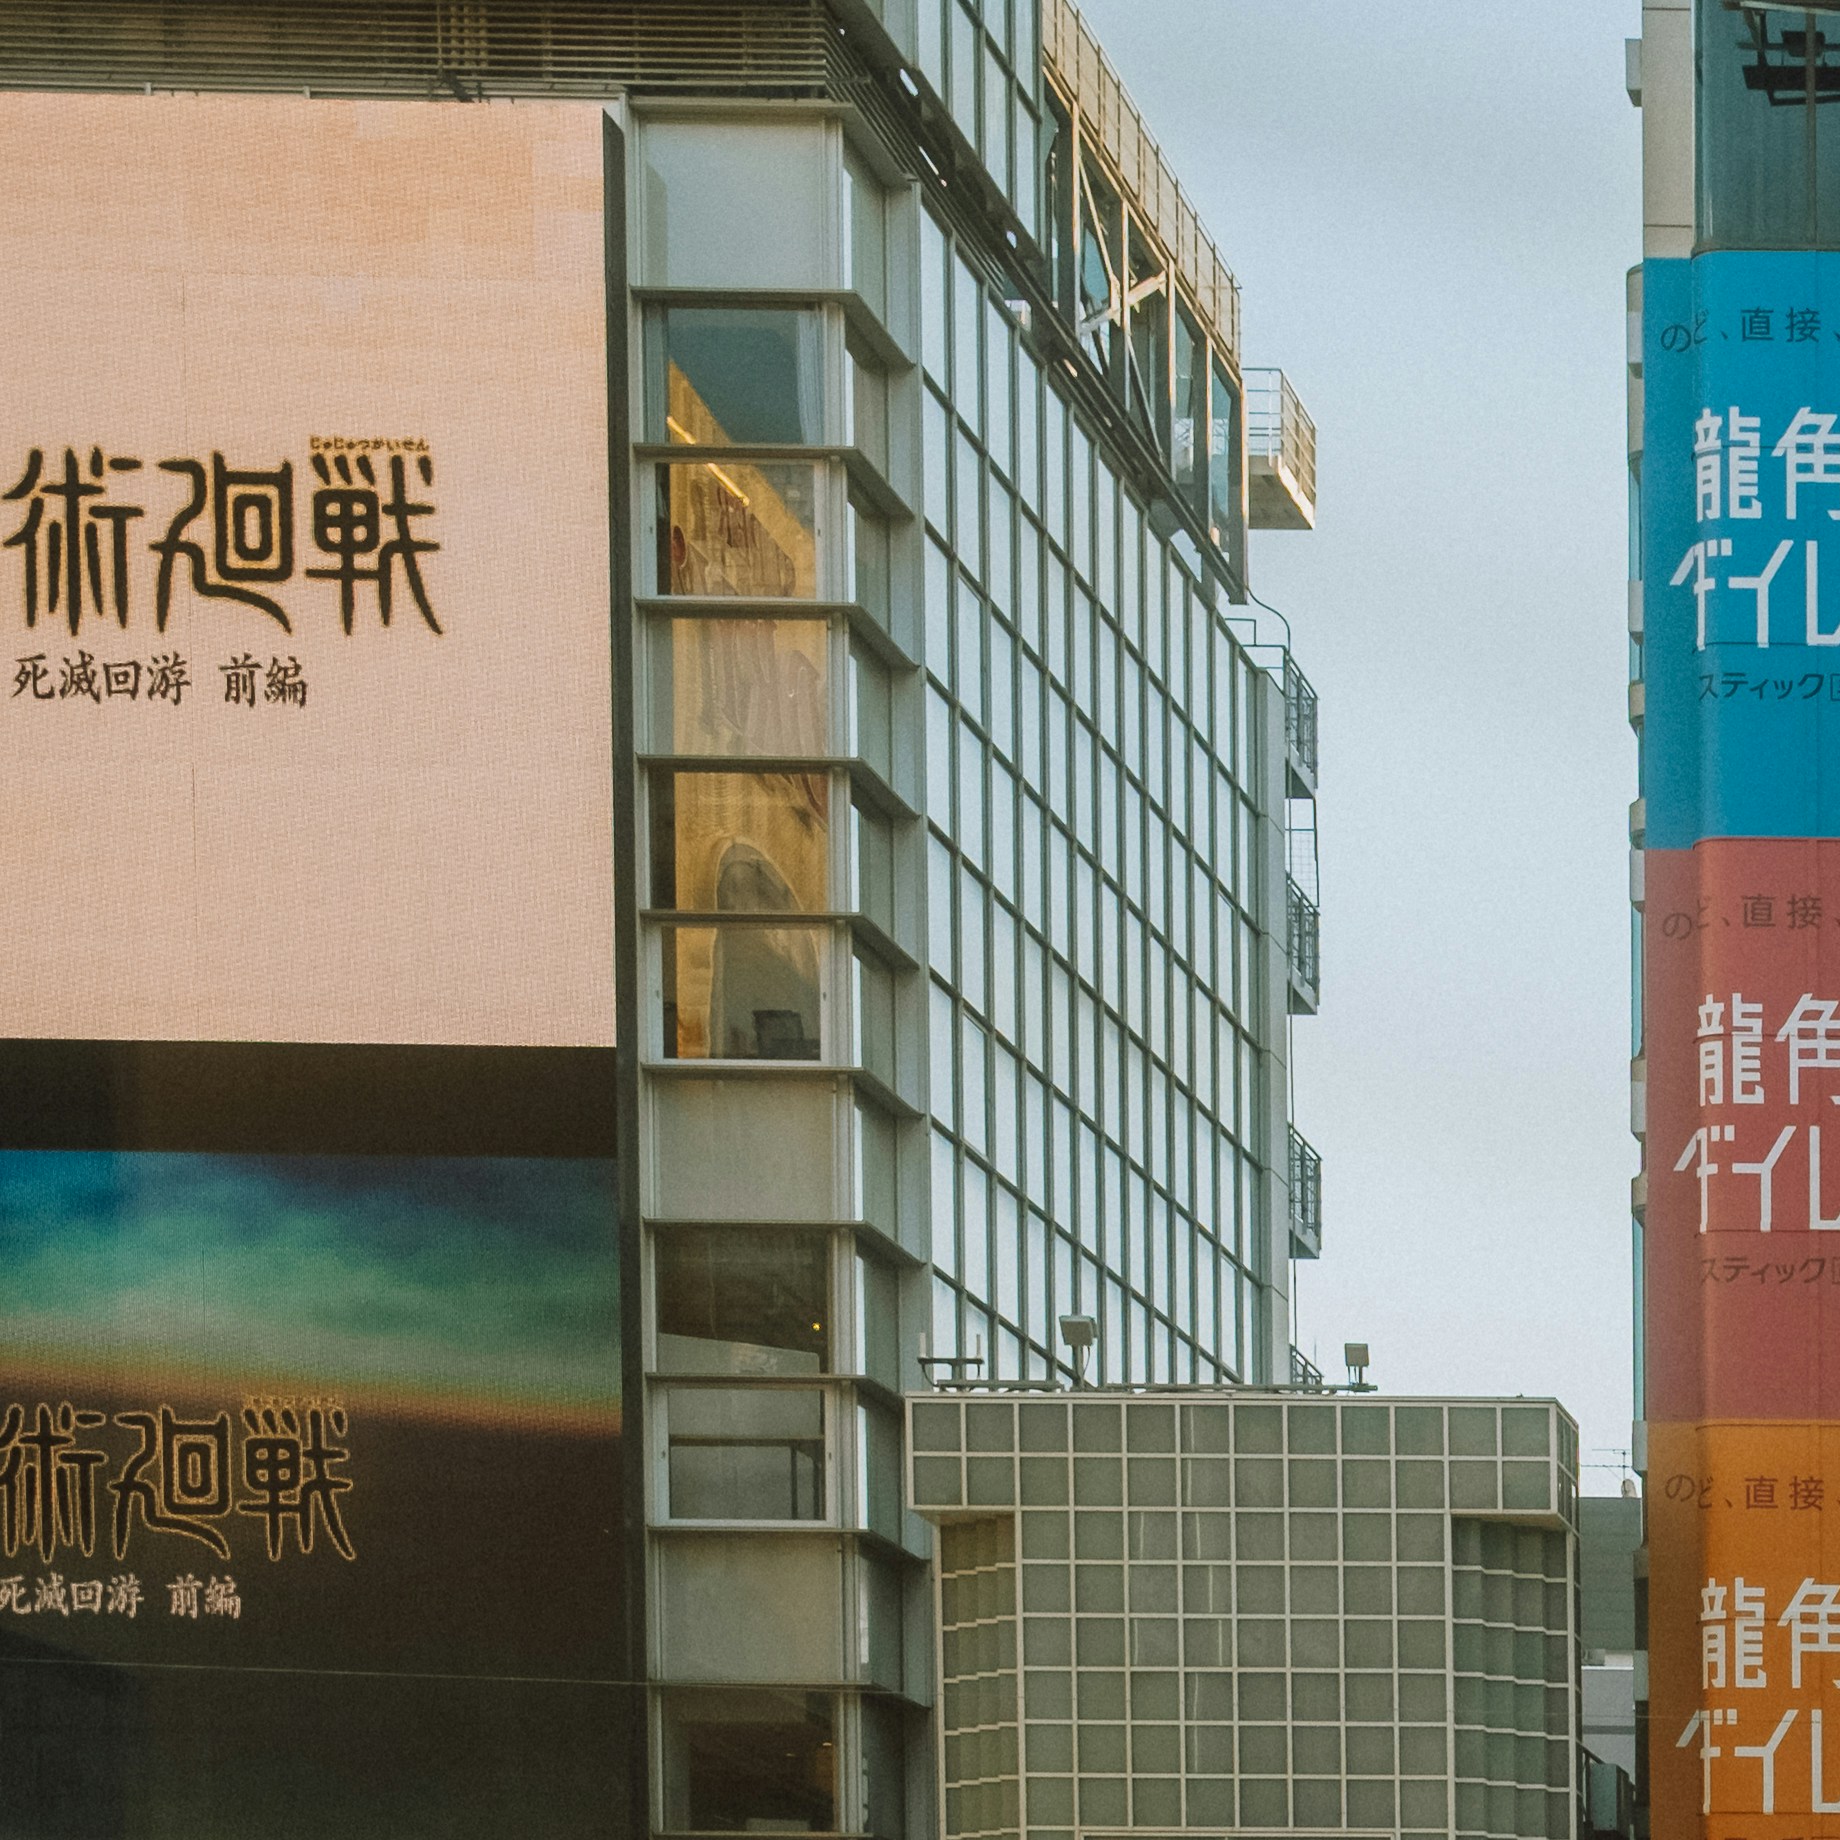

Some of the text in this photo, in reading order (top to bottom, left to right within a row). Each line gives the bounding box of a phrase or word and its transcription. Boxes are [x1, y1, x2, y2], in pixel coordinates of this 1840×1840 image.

[11, 649, 308, 707] 死滅回游 前編
[1699, 672, 1824, 701] スティック
[1701, 1257, 1826, 1285] スティック
[166, 1573, 241, 1618] 前編
